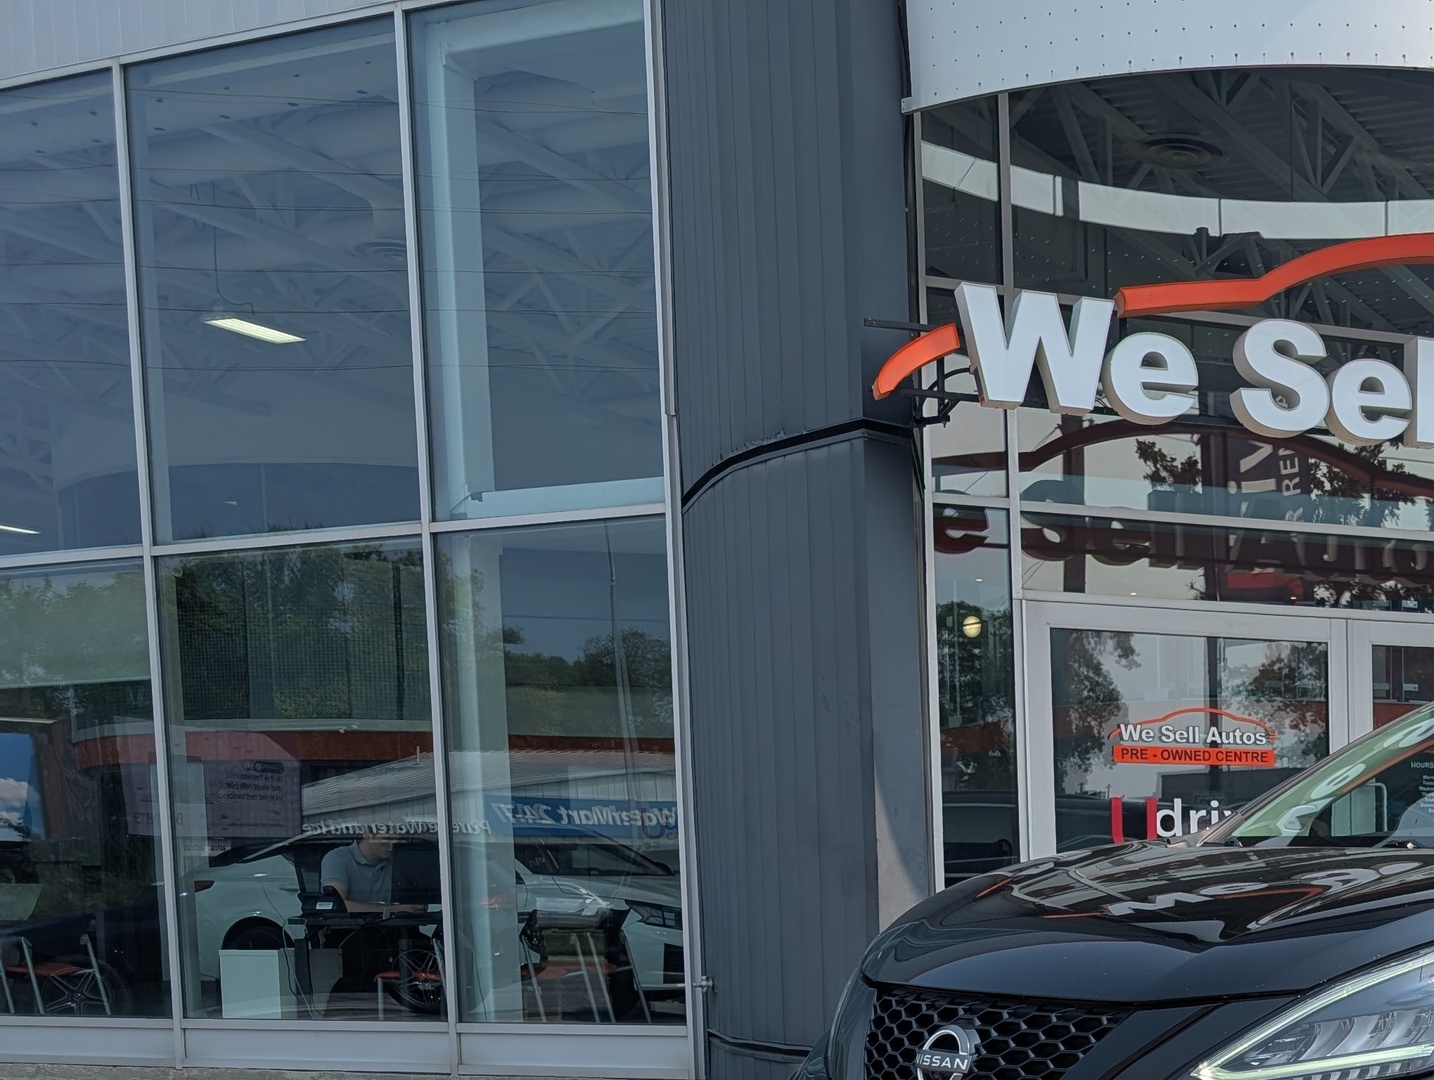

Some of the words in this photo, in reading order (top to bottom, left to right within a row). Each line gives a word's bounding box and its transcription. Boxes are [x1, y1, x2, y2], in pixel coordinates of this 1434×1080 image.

[954, 282, 1199, 425] We
[1119, 723, 1155, 742] We
[1160, 725, 1200, 743] Sell
[1206, 726, 1267, 745] Autos
[1121, 748, 1149, 760] PRE
[1160, 749, 1212, 762] OWNED
[1215, 751, 1269, 763] CENTRE
[1410, 761, 1434, 769] HOURS
[916, 1053, 968, 1071] NISSAN
